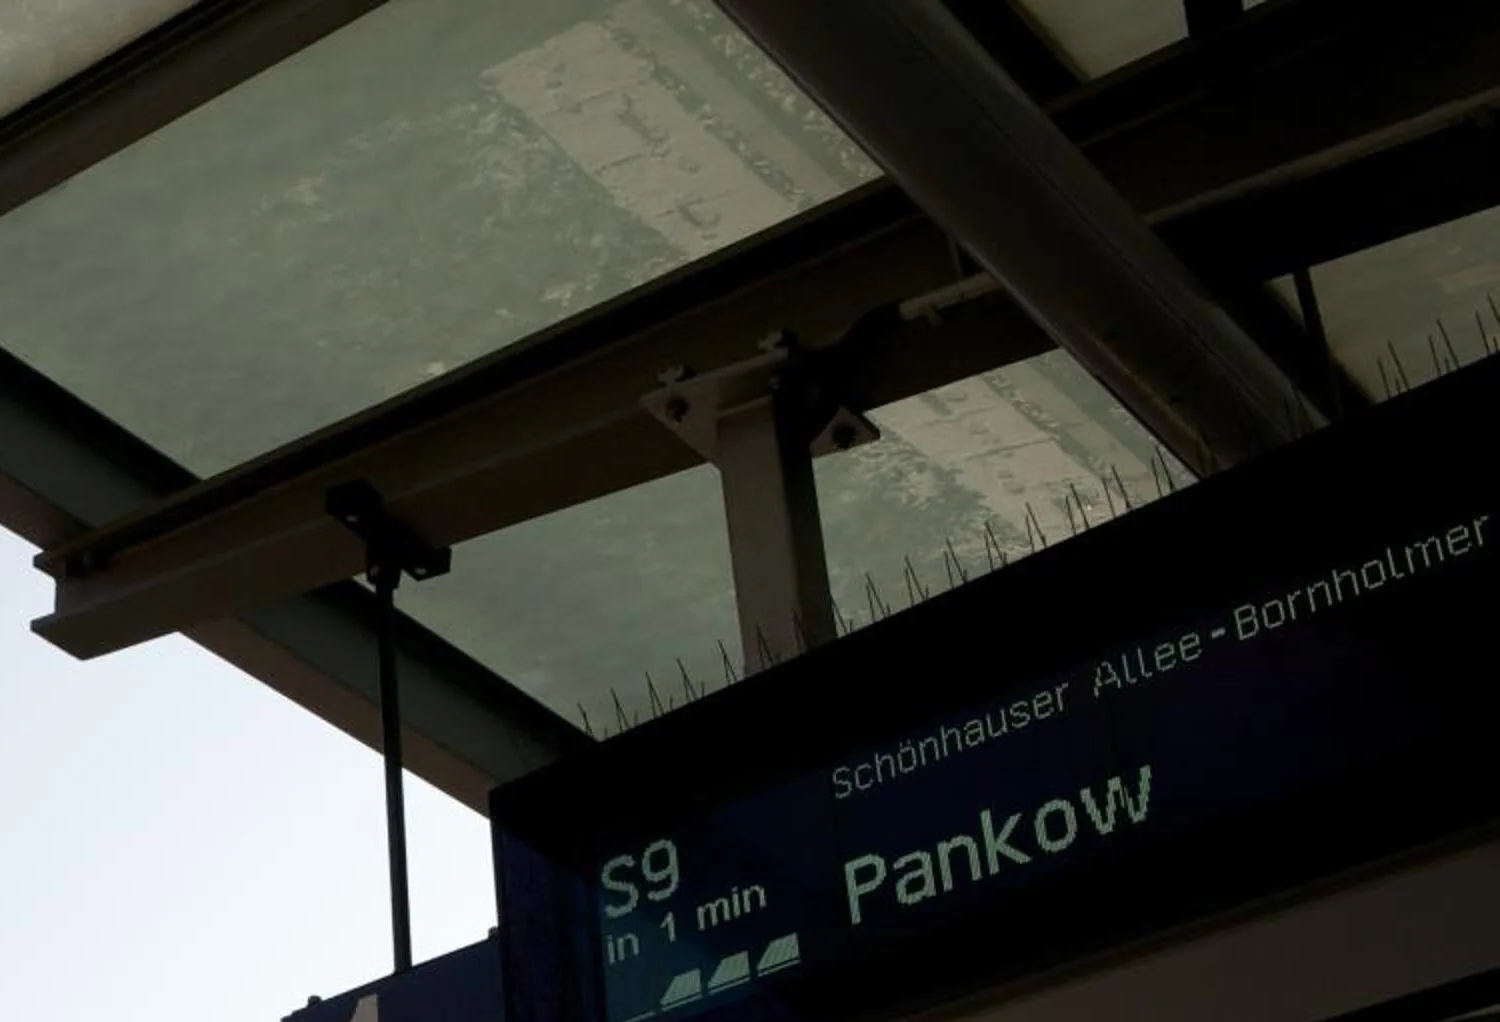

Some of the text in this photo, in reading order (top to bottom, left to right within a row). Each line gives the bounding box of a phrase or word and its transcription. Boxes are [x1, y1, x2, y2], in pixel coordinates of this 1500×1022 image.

[832, 682, 1069, 798] Schönhauser
[602, 839, 679, 917] S9
[844, 765, 1152, 924] Pankow
[606, 884, 767, 964] in 1 min
